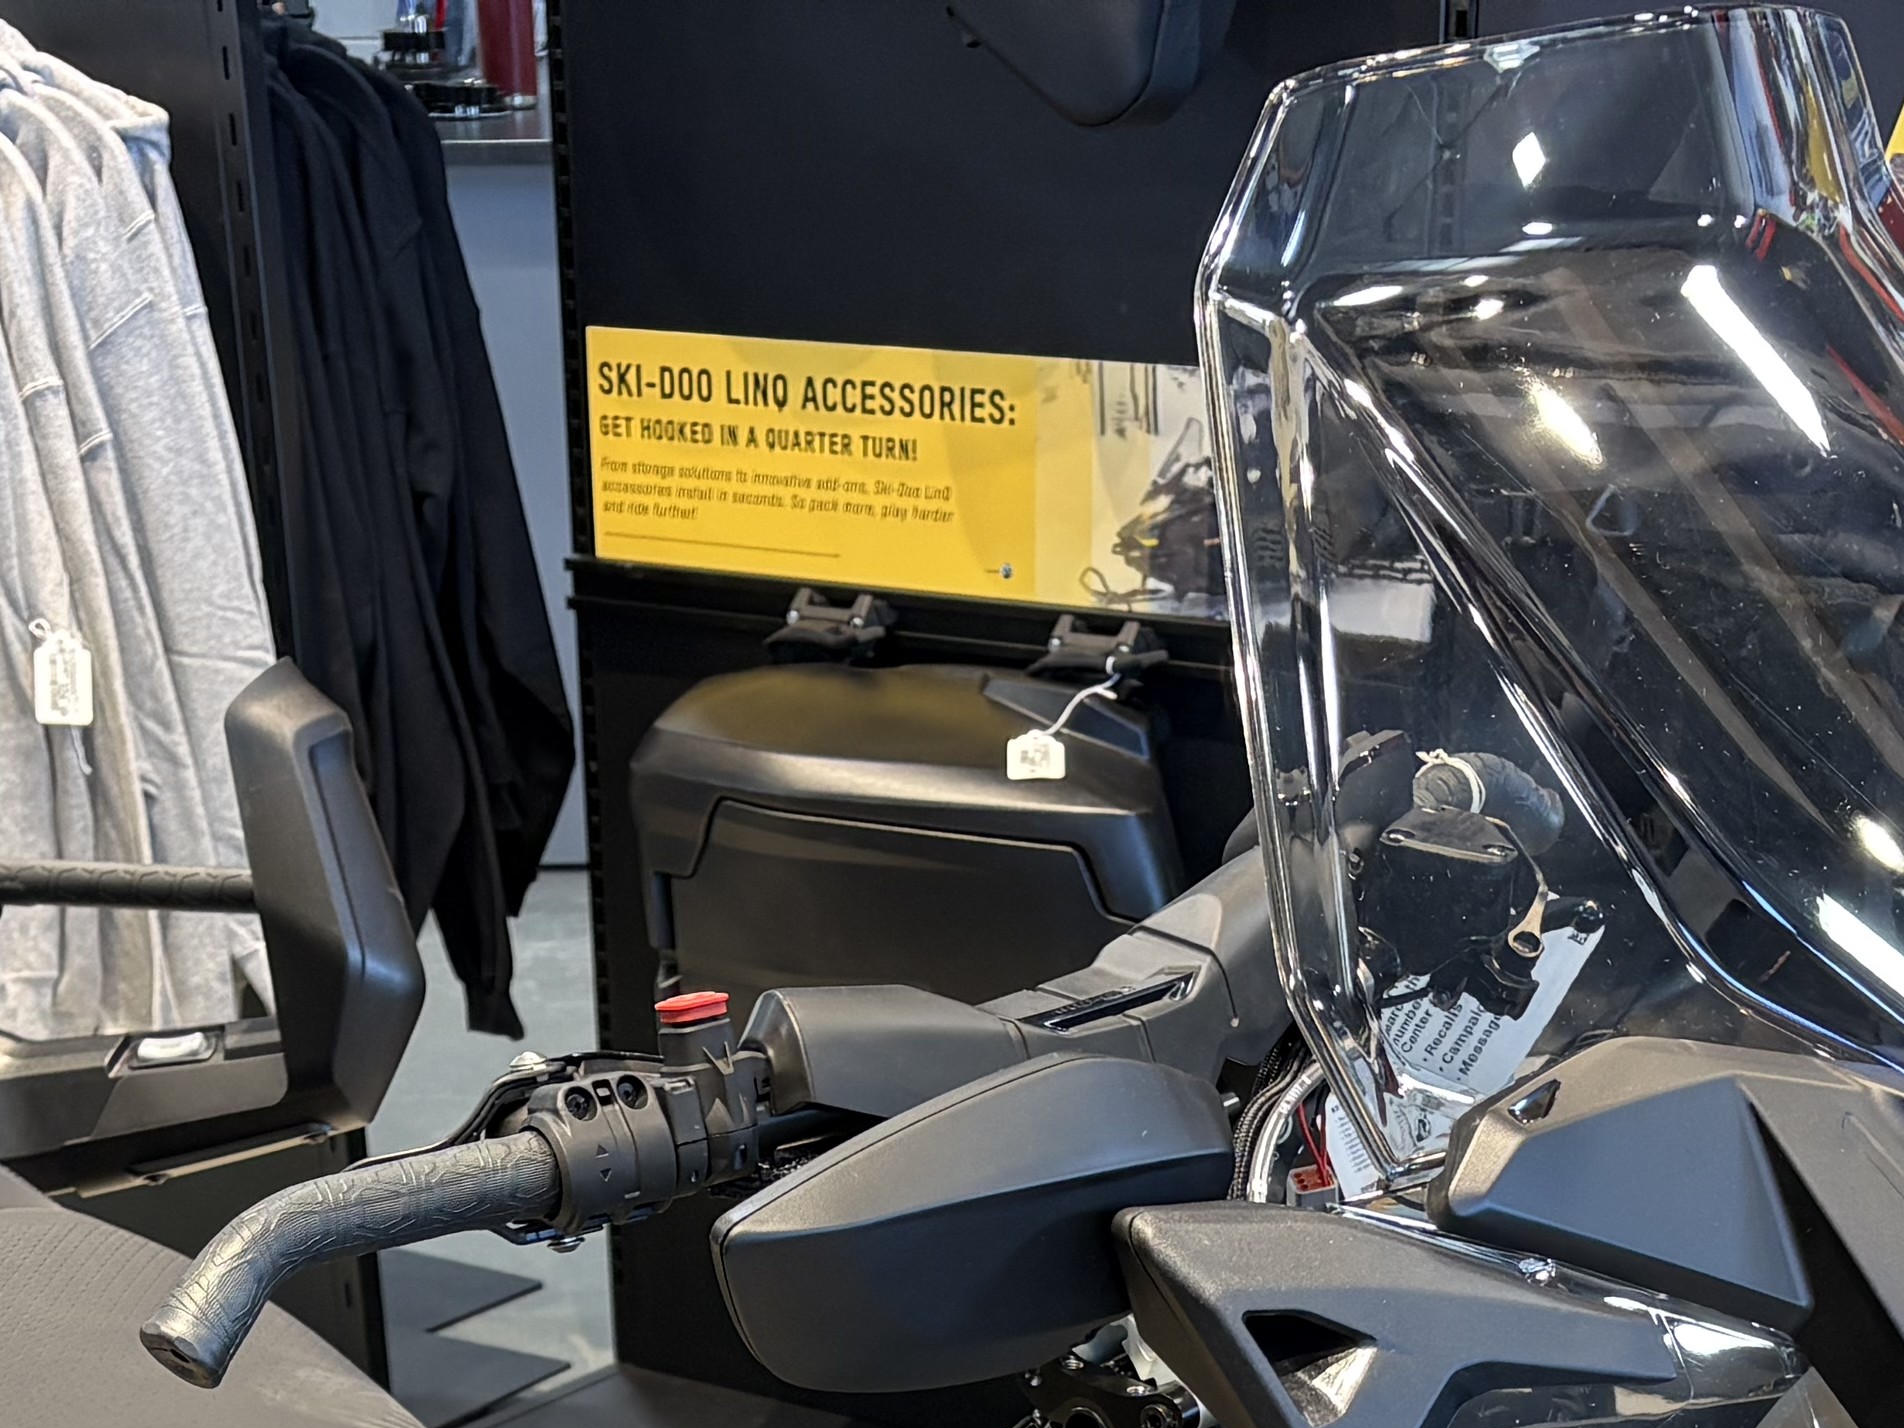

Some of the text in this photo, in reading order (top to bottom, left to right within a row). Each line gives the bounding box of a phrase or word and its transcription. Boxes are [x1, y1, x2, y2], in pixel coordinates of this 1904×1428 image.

[598, 361, 1016, 426] SKI-DOO LINQ ACCESSORIES:
[599, 414, 918, 462] GET HOOKED IN A QUARTER TURN!
